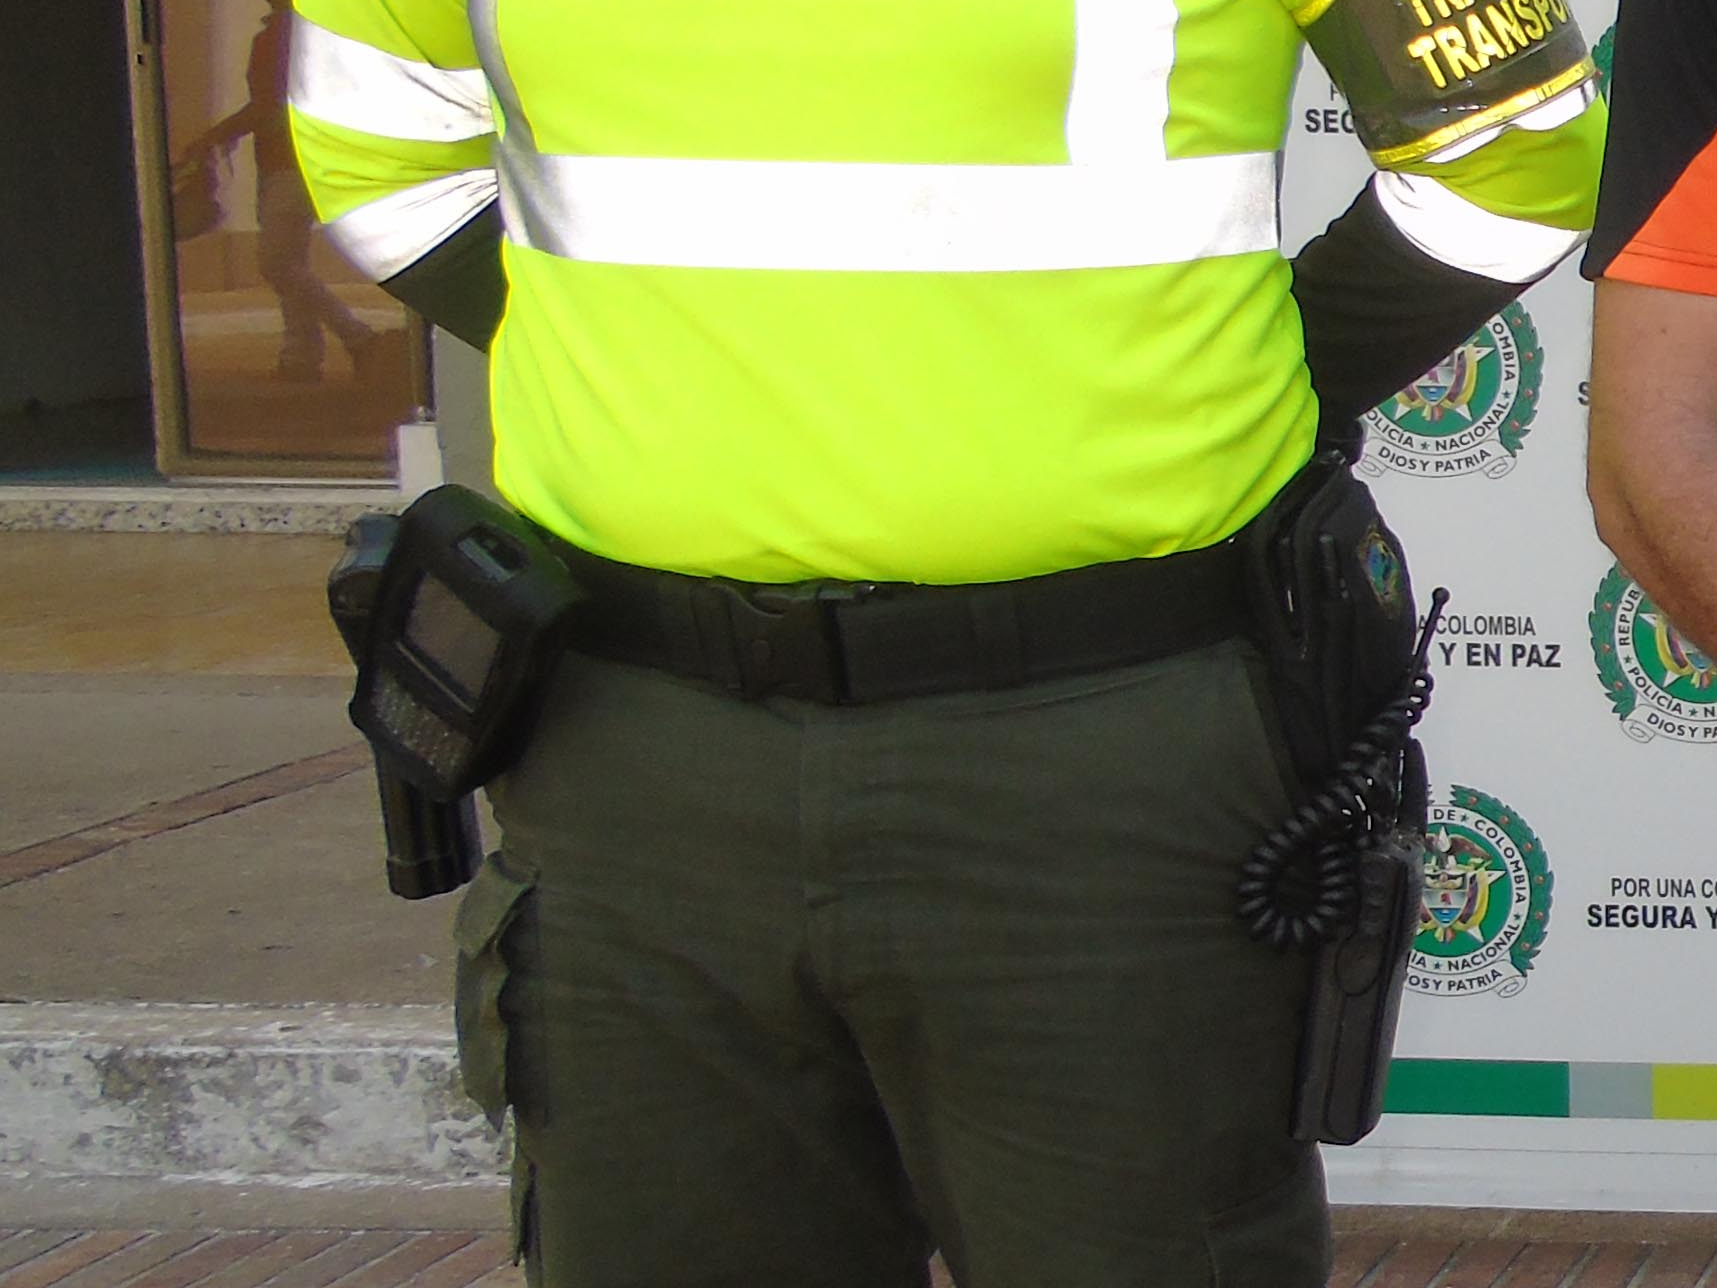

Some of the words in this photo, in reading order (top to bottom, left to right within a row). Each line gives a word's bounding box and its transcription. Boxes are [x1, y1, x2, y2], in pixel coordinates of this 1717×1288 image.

[1492, 322, 1516, 382] OMBIA
[1435, 401, 1509, 452] NACIONAL
[1378, 446, 1417, 470] DIOS
[1418, 459, 1430, 472] Y
[1435, 449, 1492, 473] PATRIA
[1436, 615, 1536, 636] COLOMBIA
[1438, 642, 1457, 666] Y
[1466, 643, 1502, 667] EN
[1511, 644, 1562, 668] PAZ
[1647, 712, 1685, 736] DIOS
[1687, 725, 1699, 738] Y
[1433, 808, 1457, 821] DE
[1474, 819, 1527, 904] COLOMBIA
[1611, 878, 1651, 898] POR
[1656, 878, 1697, 899] UNA
[1587, 904, 1698, 929] SEGURA
[1447, 919, 1521, 972] NACIONAL
[1447, 968, 1503, 992] PATRIA
